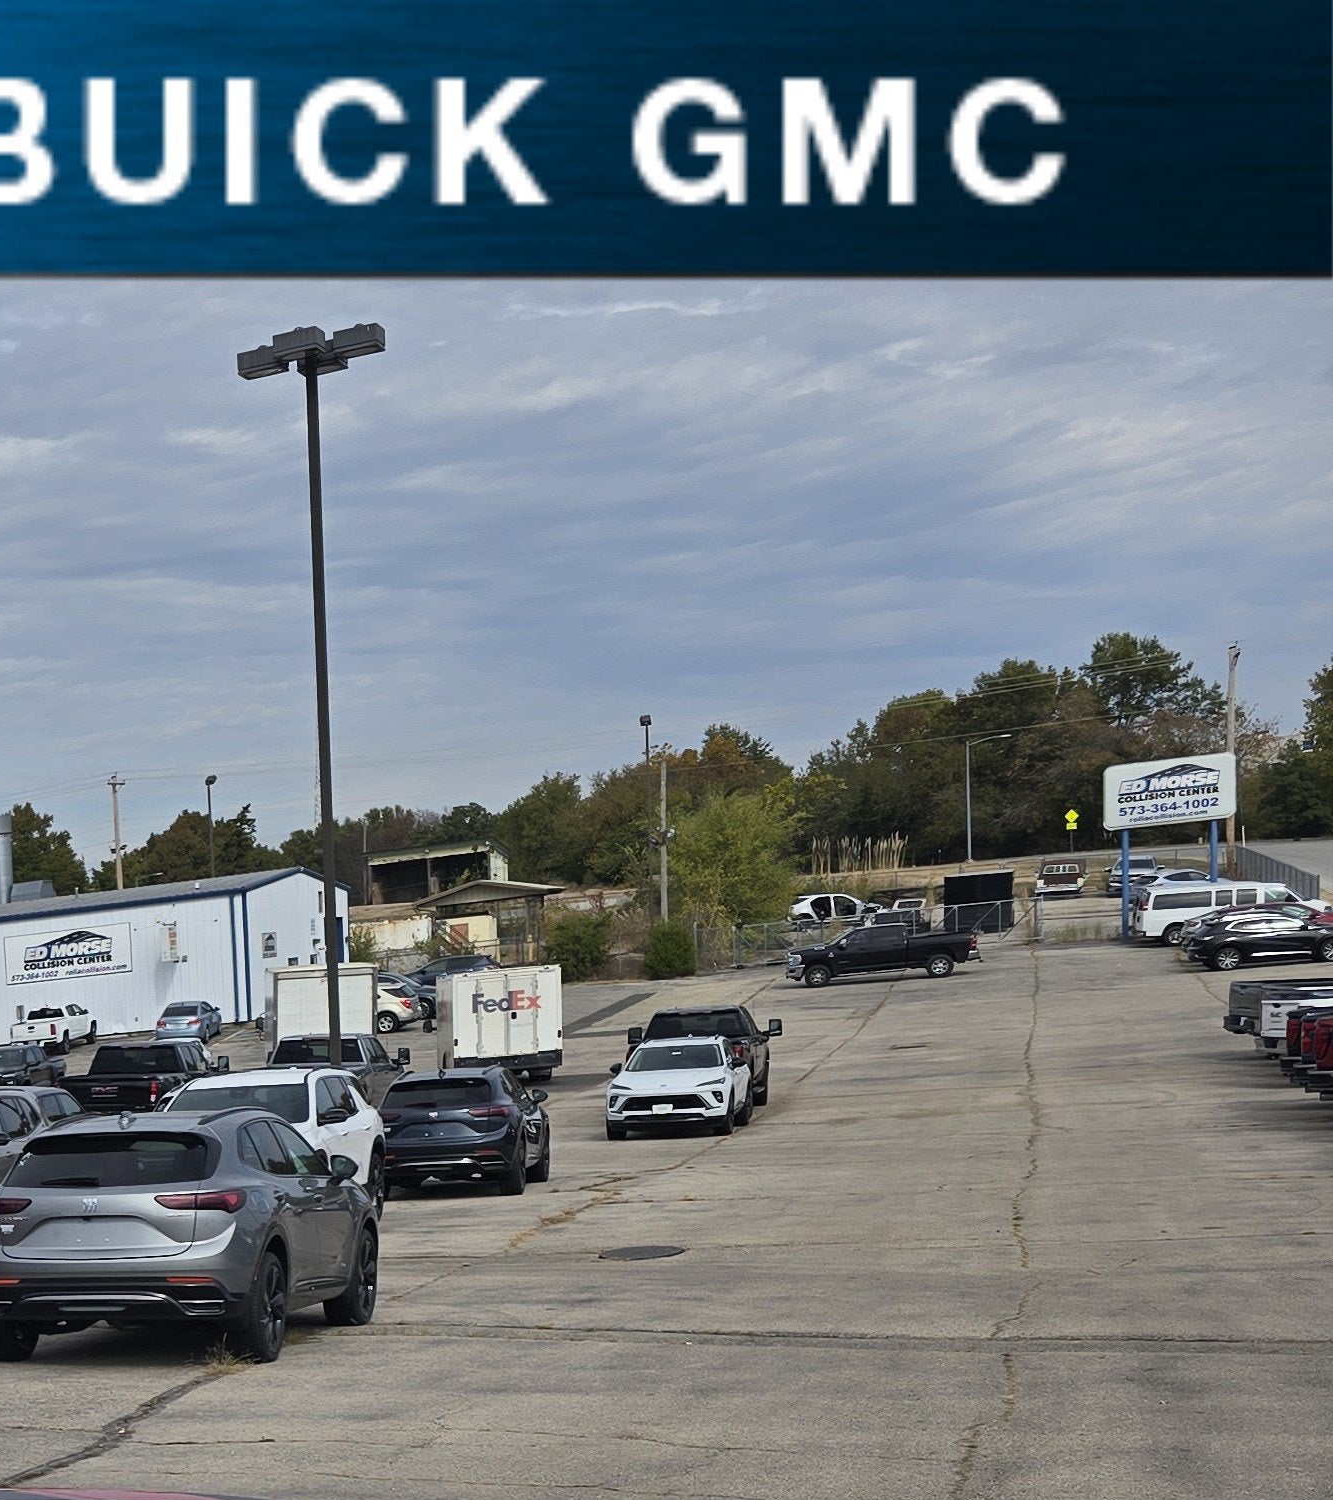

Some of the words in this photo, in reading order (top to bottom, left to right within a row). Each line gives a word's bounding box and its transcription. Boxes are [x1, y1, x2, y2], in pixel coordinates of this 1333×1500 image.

[1119, 780, 1147, 794] ED
[1149, 769, 1220, 790] MORSE
[1118, 791, 1175, 804] COLLISION
[1178, 786, 1219, 797] CENTER
[1119, 797, 1219, 817] 573-364-1002
[25, 947, 48, 960] ED
[50, 938, 112, 959] MORSE
[24, 958, 75, 972] COLLISION
[77, 954, 112, 965] CENTER
[472, 989, 542, 1013] FedEx
